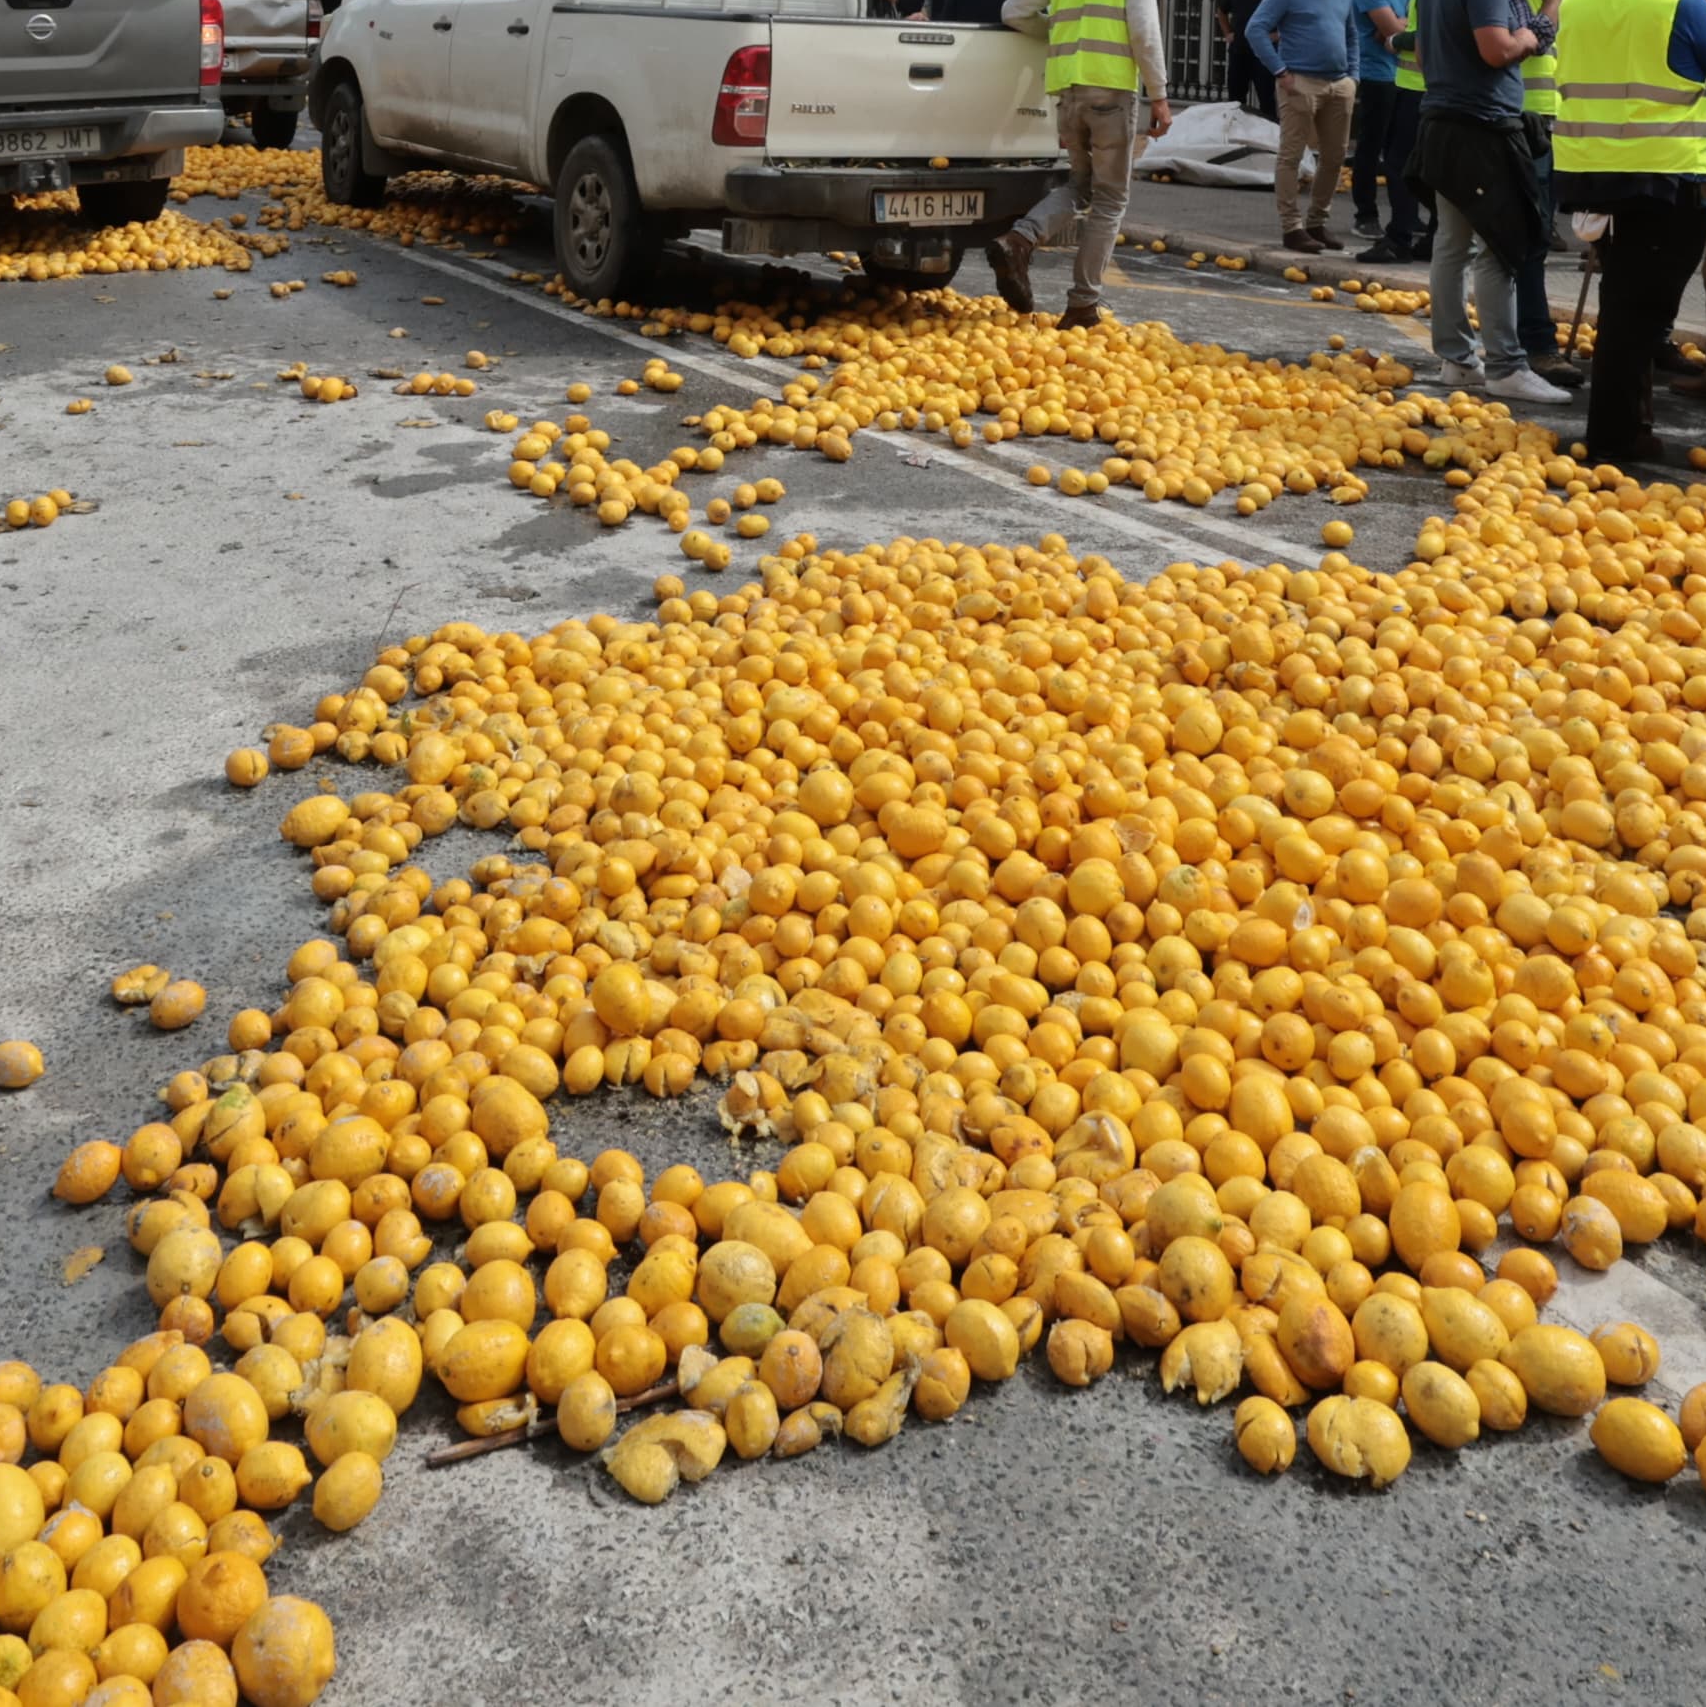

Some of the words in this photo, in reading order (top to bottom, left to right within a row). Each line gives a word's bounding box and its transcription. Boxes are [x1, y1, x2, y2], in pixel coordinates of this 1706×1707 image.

[791, 102, 837, 115] HILUX
[56, 127, 95, 150] JMT
[888, 194, 935, 218] 4416
[942, 193, 979, 217] HJM
